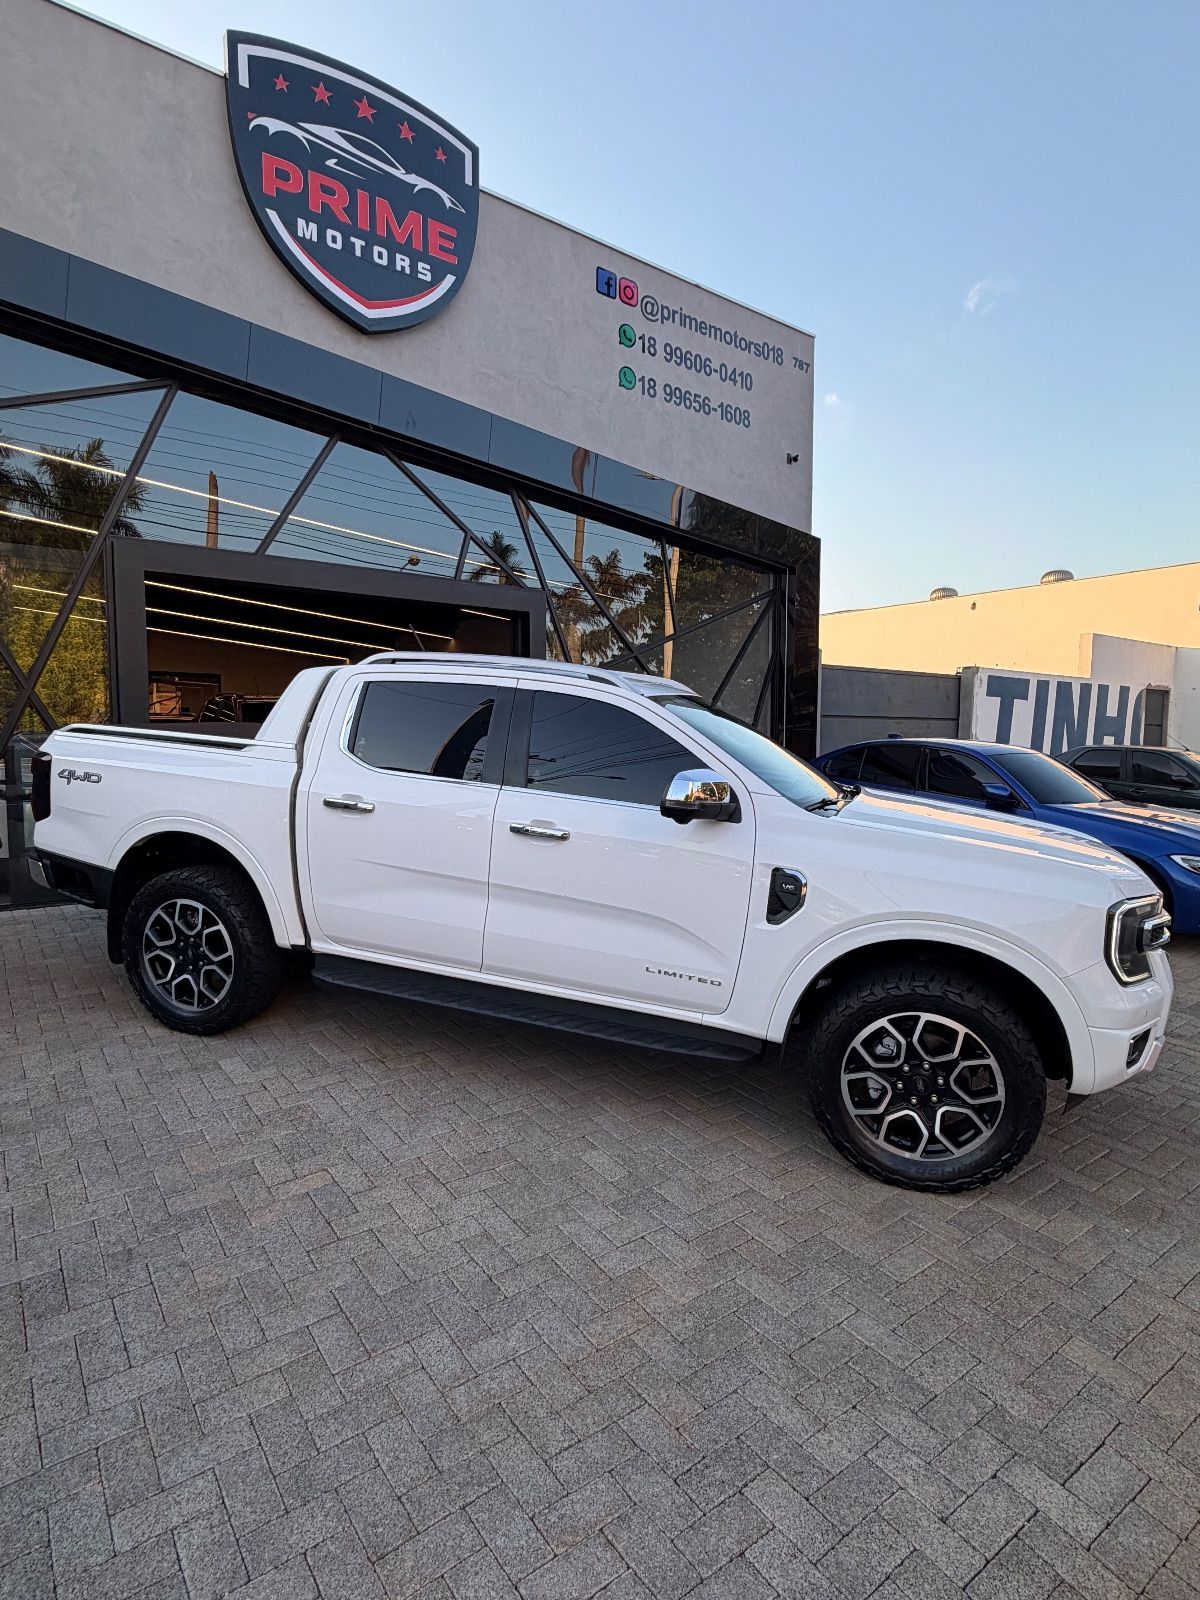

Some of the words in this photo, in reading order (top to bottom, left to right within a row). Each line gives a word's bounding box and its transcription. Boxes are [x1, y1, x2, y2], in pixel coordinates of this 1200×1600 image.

[261, 151, 458, 265] PRIME
[297, 217, 432, 282] MOTORS
[640, 294, 784, 367] @primemotors018
[638, 333, 658, 358] 18
[663, 342, 754, 392] 99606-0410
[792, 356, 811, 374] 787
[638, 375, 657, 399] 18
[663, 383, 751, 429] 99656-1608
[57, 768, 103, 786] 4WD
[645, 966, 722, 987] LIMITED
